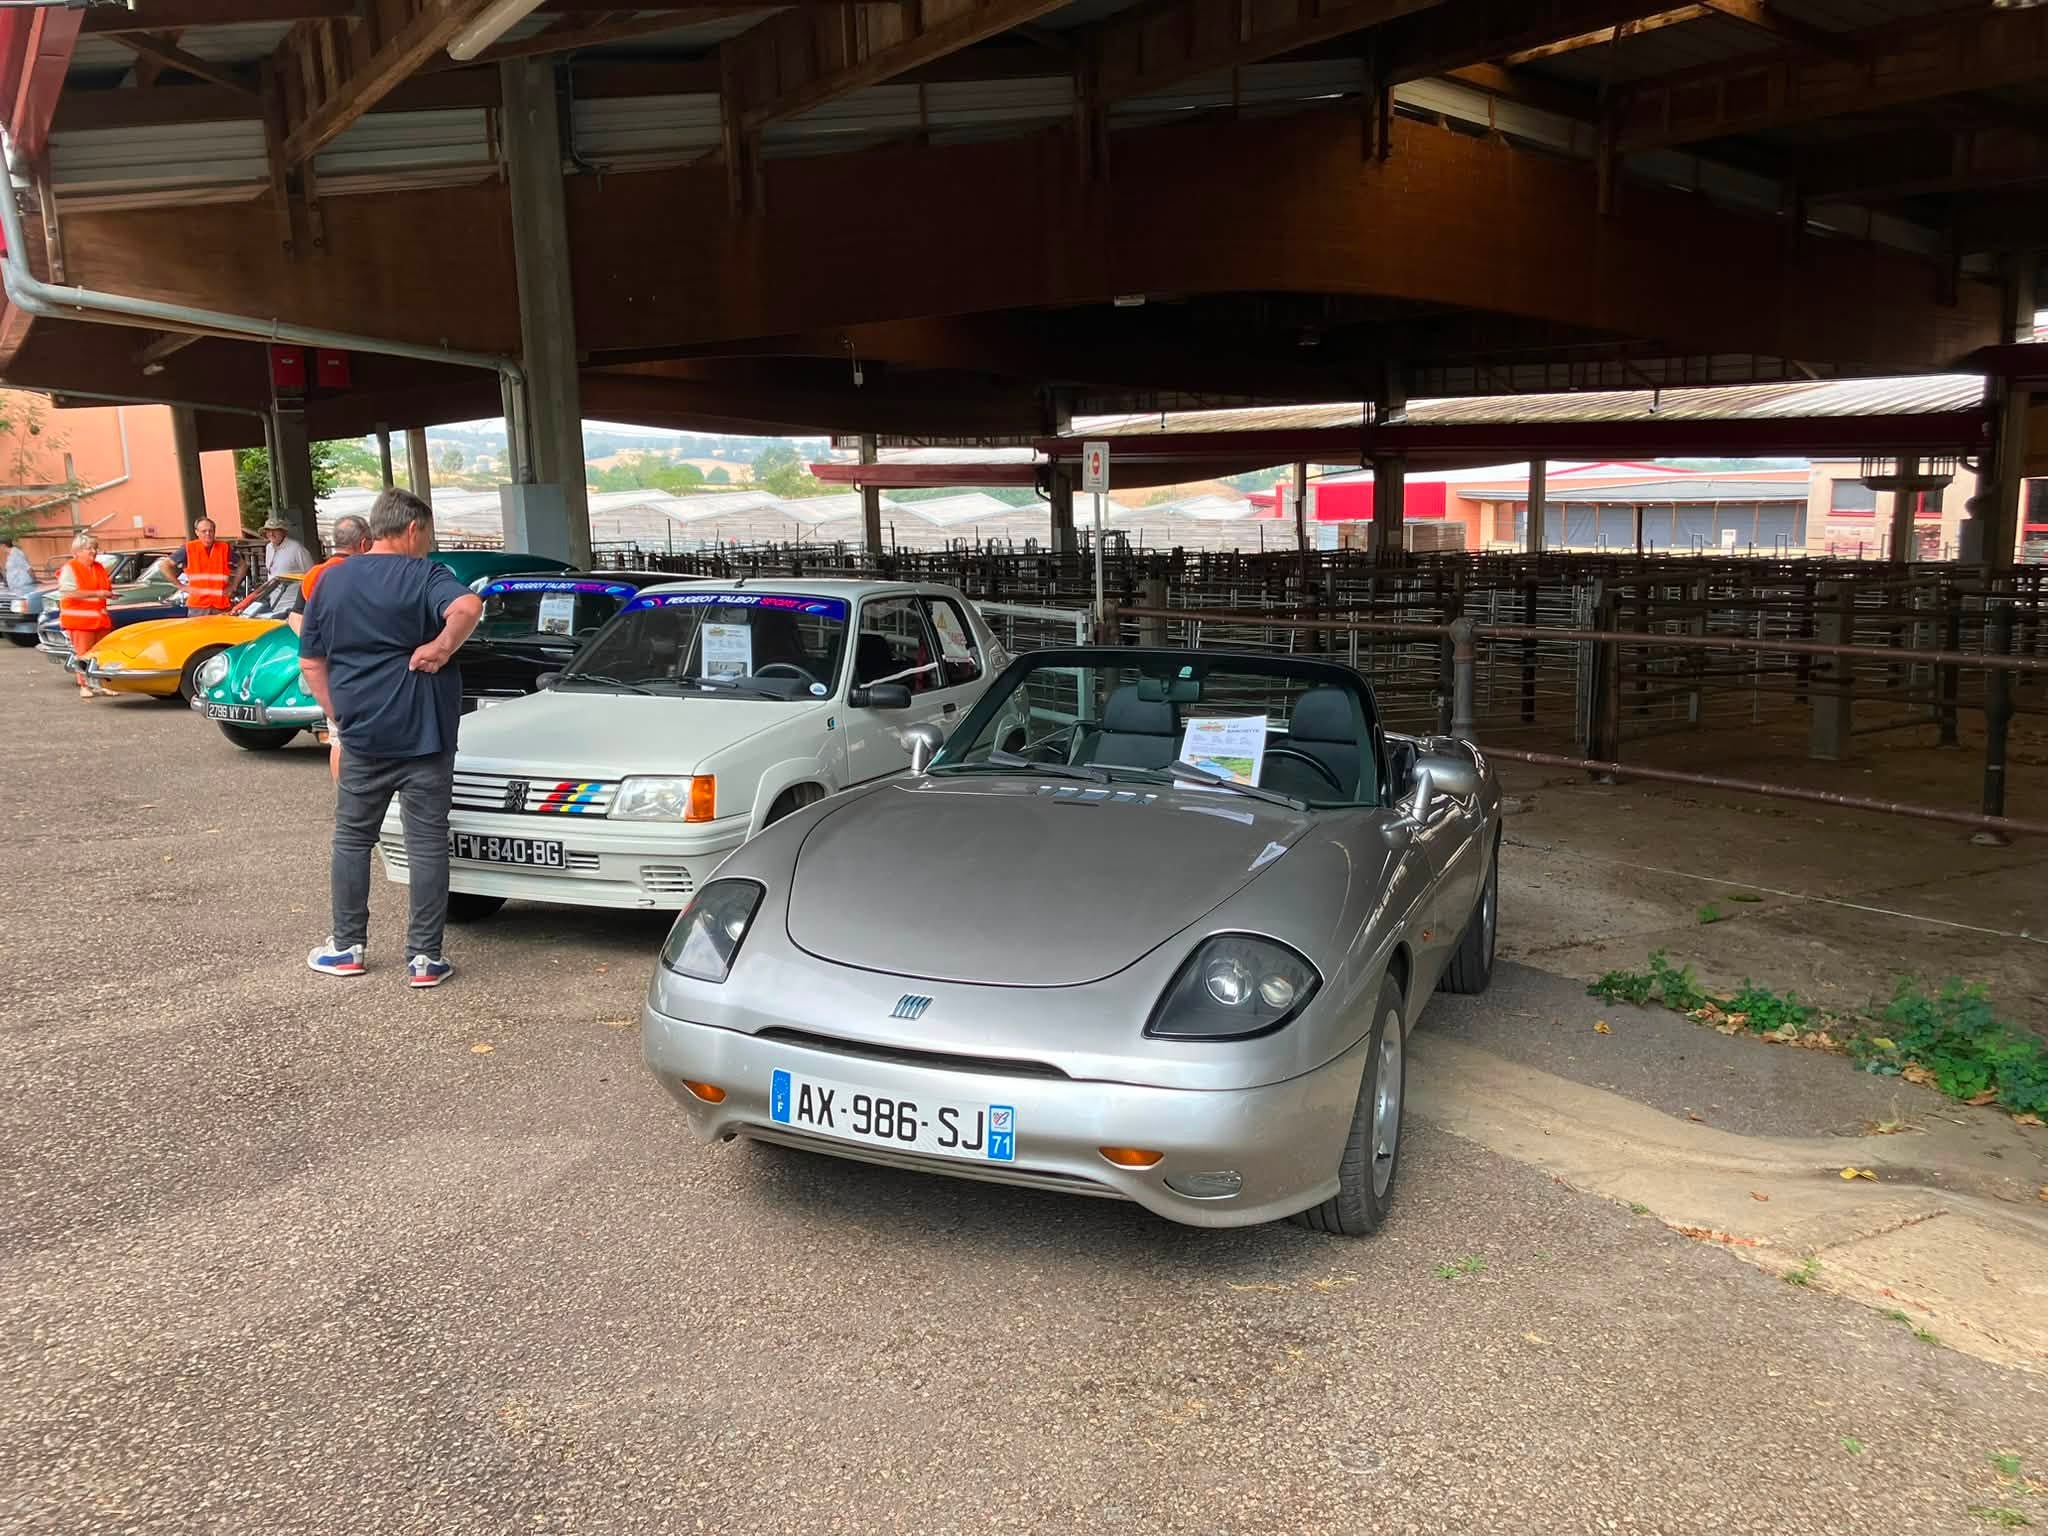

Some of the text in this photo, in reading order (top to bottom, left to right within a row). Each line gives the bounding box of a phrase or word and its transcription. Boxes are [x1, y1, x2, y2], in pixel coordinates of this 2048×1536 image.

[665, 595, 717, 605] PEUGEOT
[718, 595, 761, 604] TALBOT
[243, 707, 254, 720] 71
[457, 834, 560, 865] FW-840-BG
[777, 1100, 784, 1113] F
[991, 1135, 1011, 1155] 71
